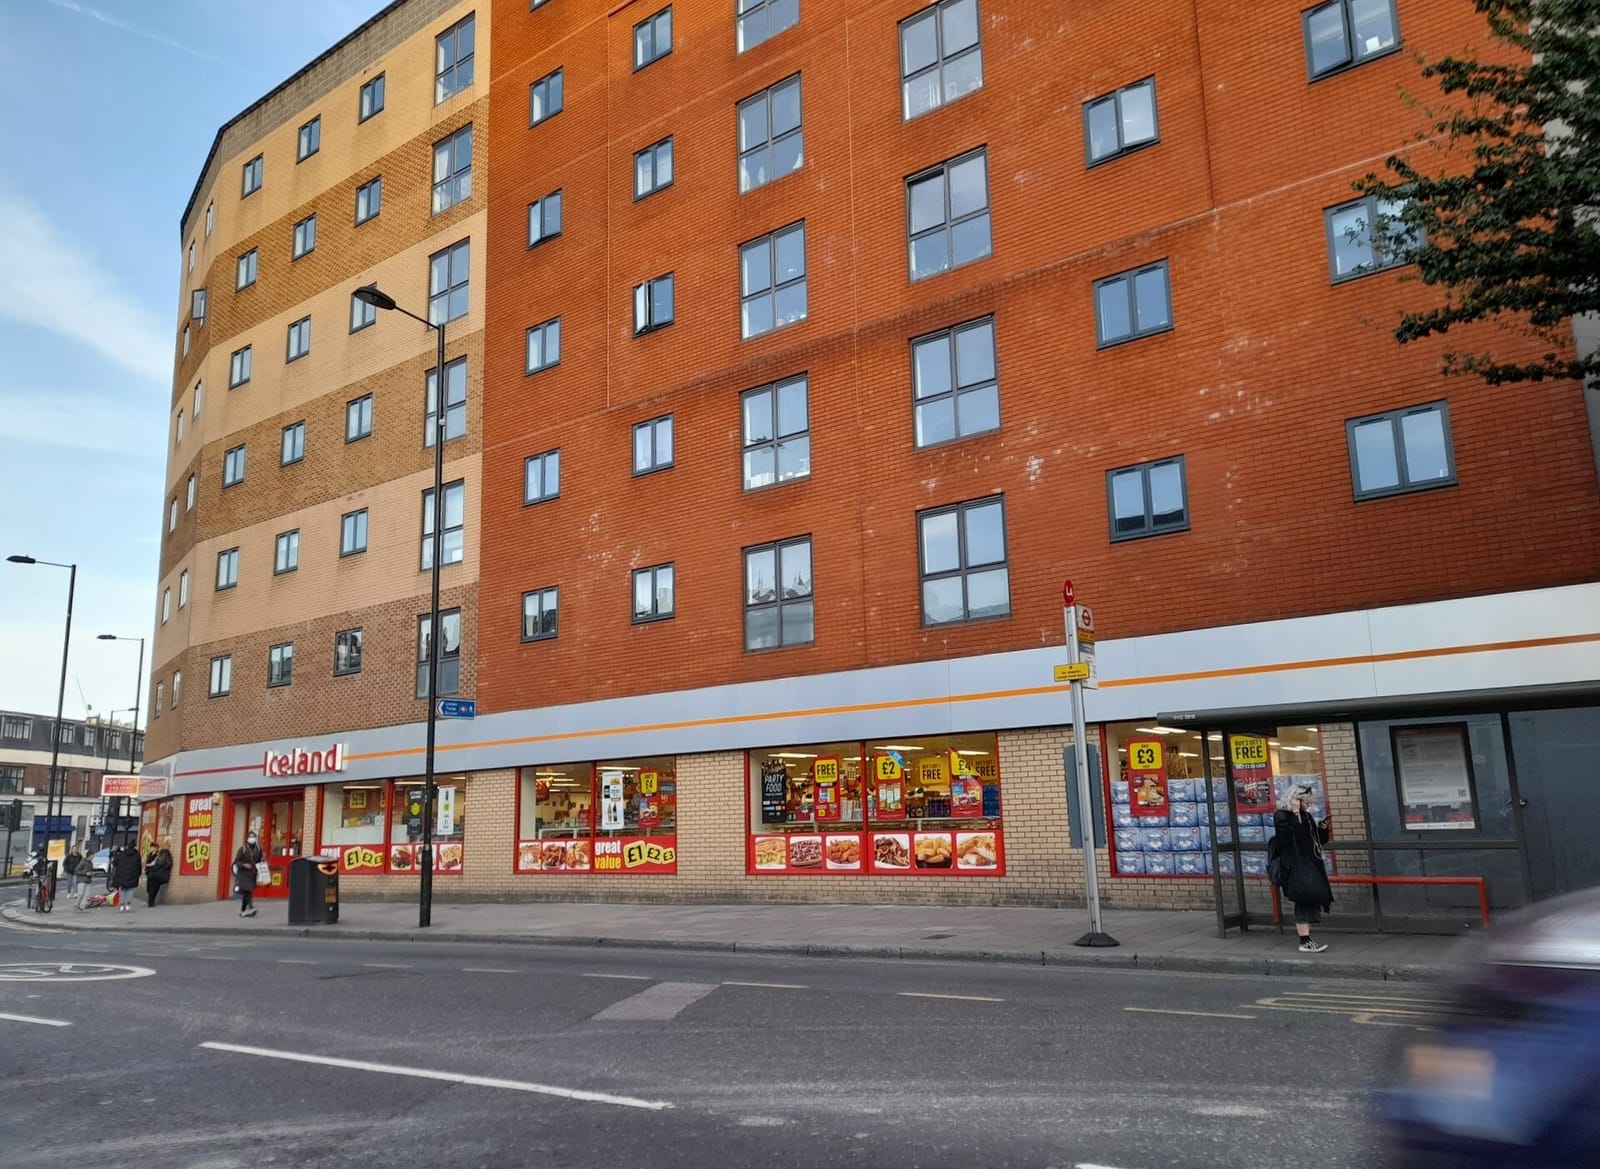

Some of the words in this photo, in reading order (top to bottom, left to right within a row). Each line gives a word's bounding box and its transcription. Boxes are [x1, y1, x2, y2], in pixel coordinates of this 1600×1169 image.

[263, 743, 342, 777] Iceland
[1137, 748, 1155, 764] £3
[1235, 745, 1263, 760] FREE
[816, 763, 836, 776] FREE
[882, 761, 895, 775] £2
[958, 760, 974, 771] £4
[976, 765, 996, 777] FREE
[764, 773, 785, 784] PARTY
[922, 768, 942, 780] FREE
[765, 783, 782, 793] FOOD
[189, 796, 213, 814] great
[188, 812, 212, 828] value
[188, 843, 198, 859] £1
[594, 840, 621, 855] great
[627, 844, 643, 863] £1
[647, 847, 661, 860] £2
[663, 850, 674, 862] £3
[347, 850, 359, 867] £1
[362, 852, 373, 865] £2
[594, 855, 621, 870] value
